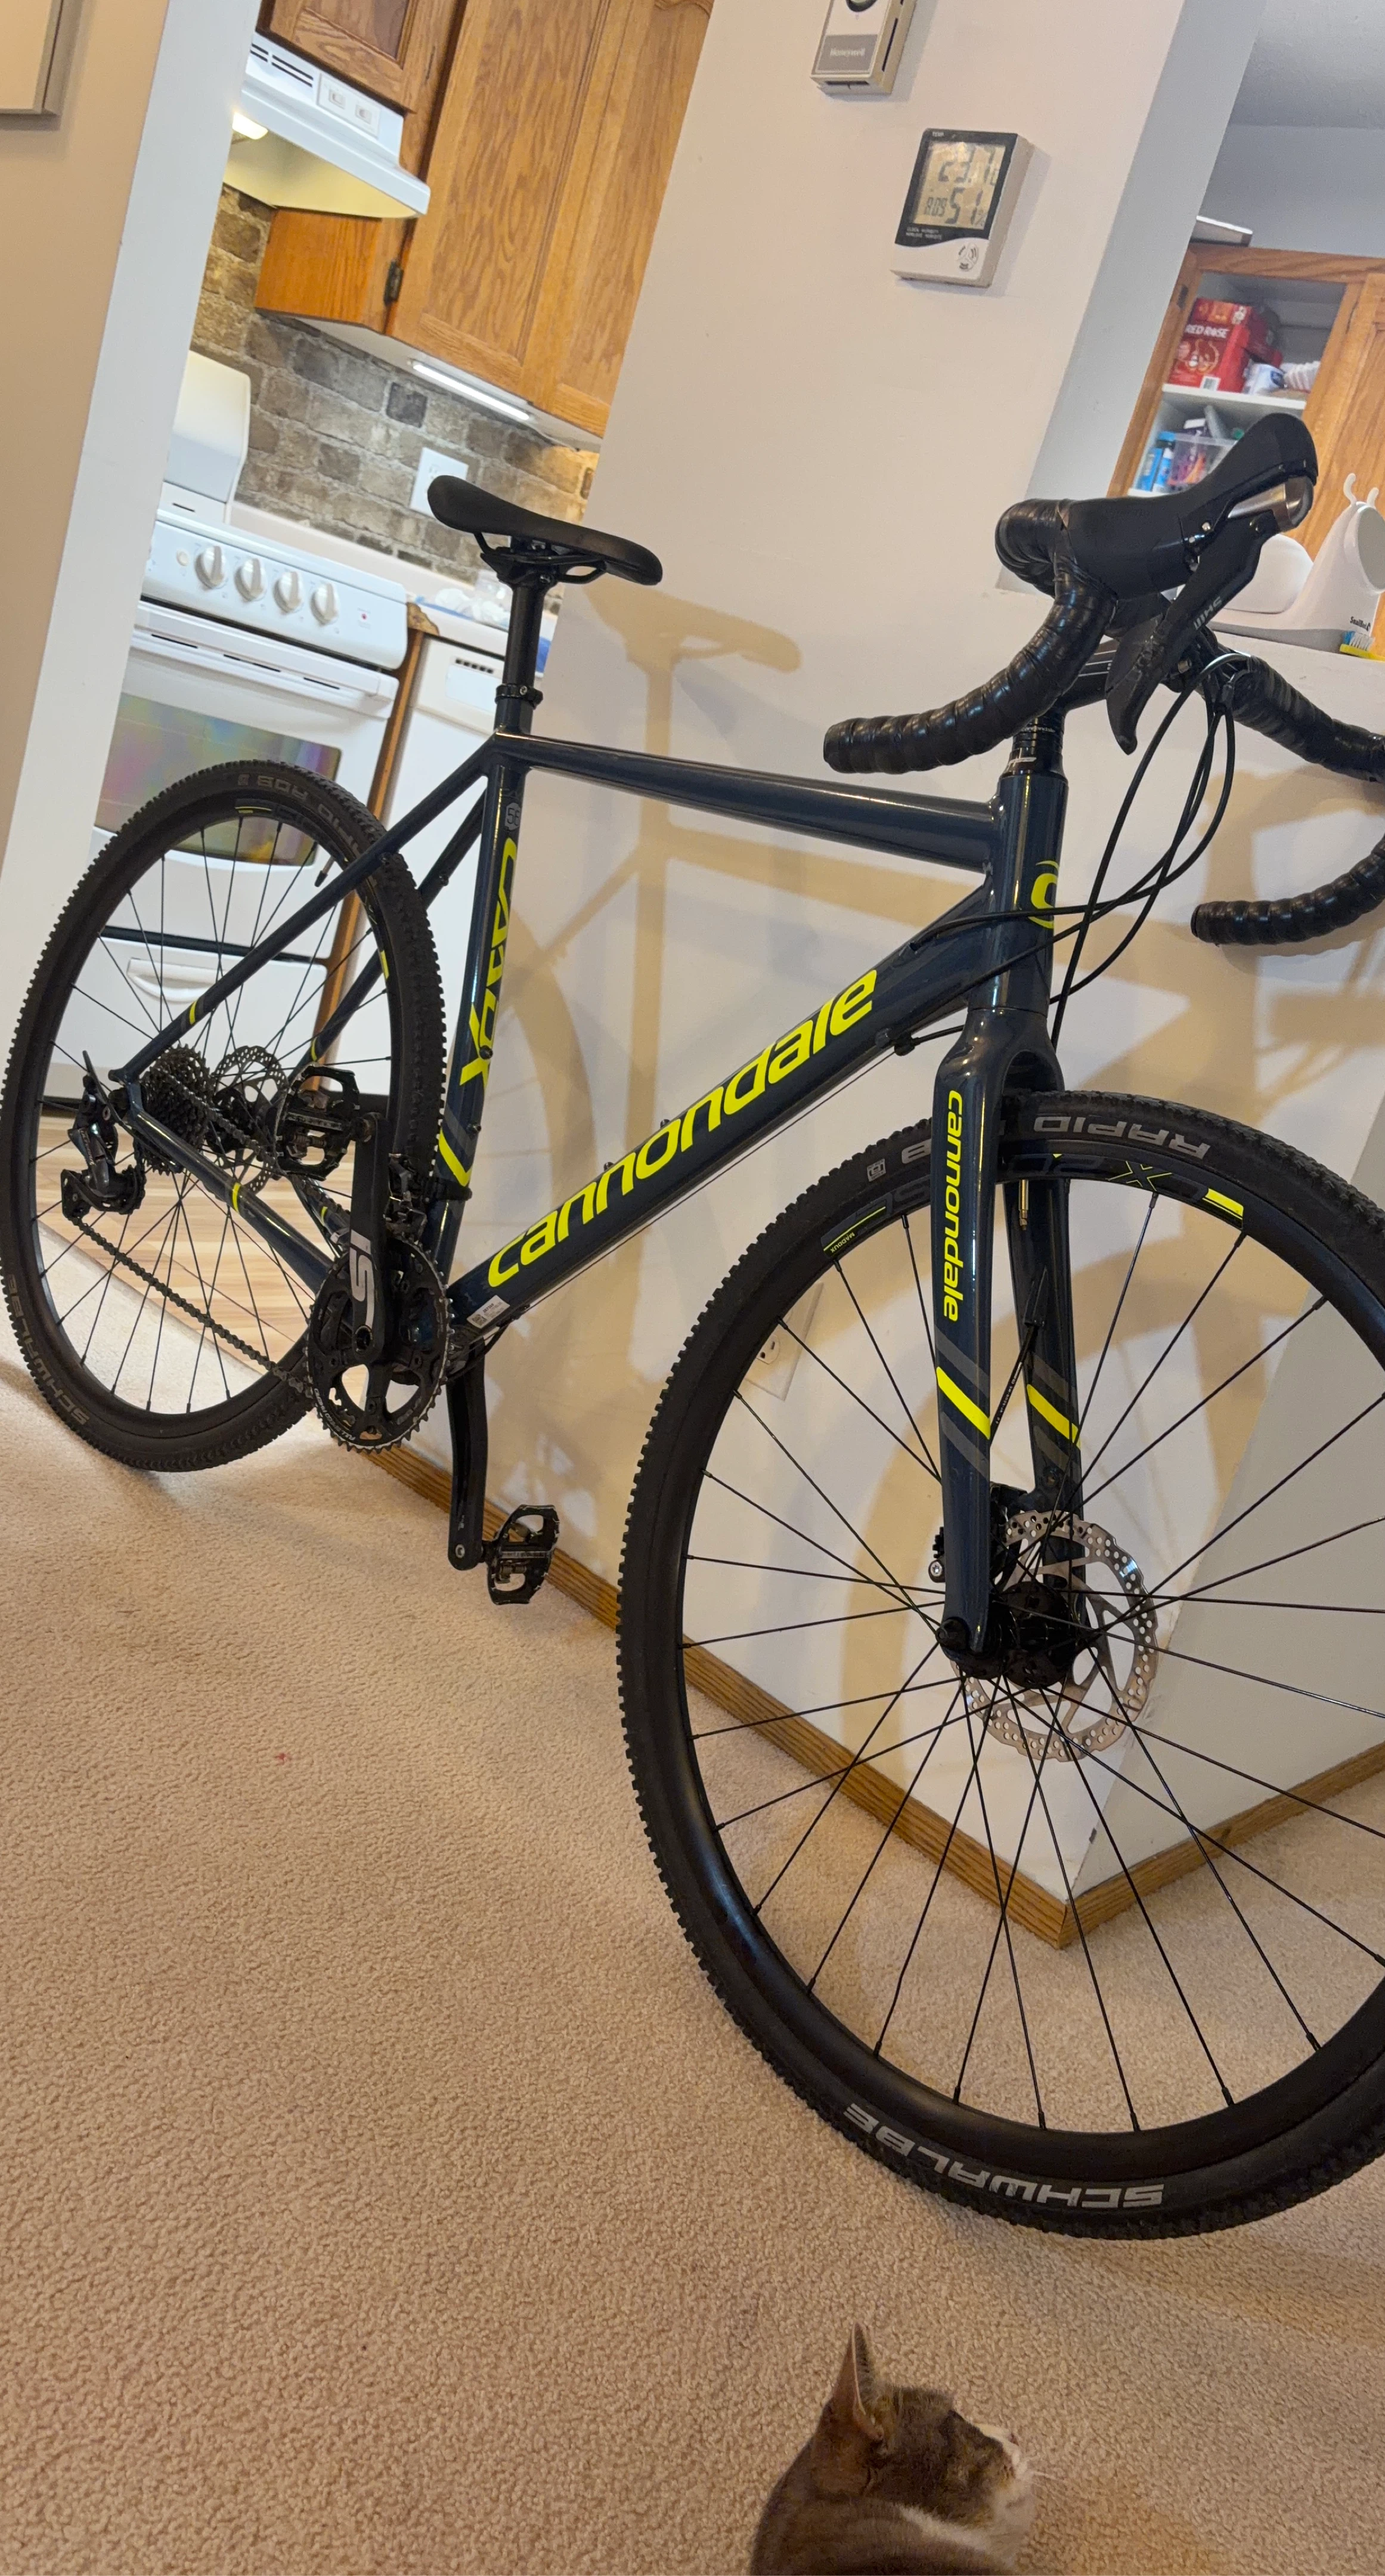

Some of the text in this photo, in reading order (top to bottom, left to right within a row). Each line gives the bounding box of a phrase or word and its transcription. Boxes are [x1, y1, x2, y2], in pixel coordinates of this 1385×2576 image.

[1185, 324, 1229, 339] RED ROSE
[507, 807, 520, 826] 56
[488, 970, 878, 1288] cannondale
[1033, 1116, 1212, 1160] RAPID
[830, 1231, 856, 1253] MADDUX
[943, 1089, 964, 1323] cannondale
[8, 1274, 90, 1425] SCHWALBE
[844, 2103, 1164, 2209] SCHWALBE
